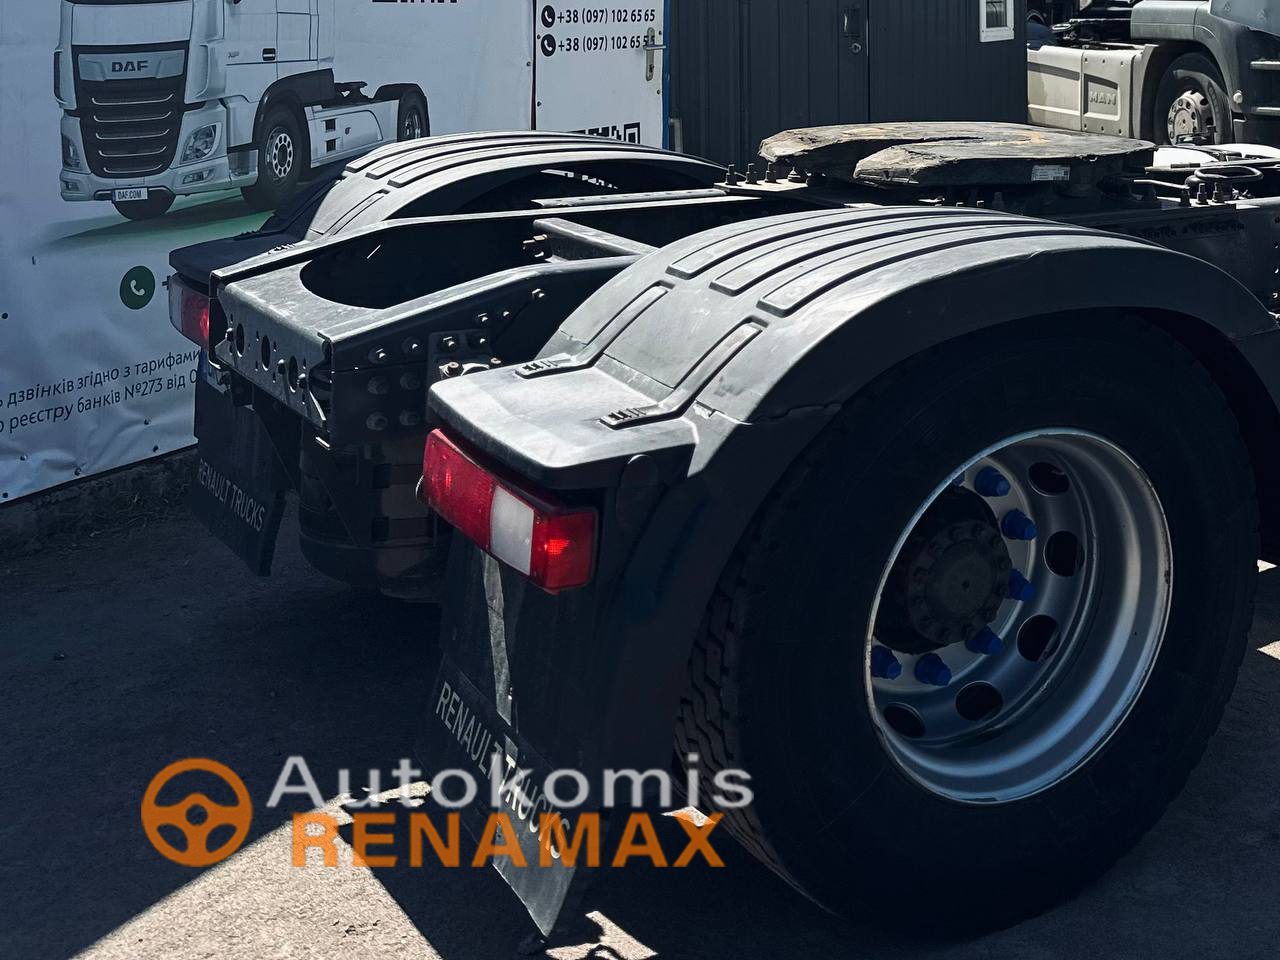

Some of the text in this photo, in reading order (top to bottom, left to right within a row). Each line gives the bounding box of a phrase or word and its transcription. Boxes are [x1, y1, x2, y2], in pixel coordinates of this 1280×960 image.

[557, 7, 656, 25] +38 (097) 102 65 65
[558, 37, 580, 52] +38
[582, 36, 608, 52] (097)
[611, 36, 627, 50] 102
[629, 35, 641, 48] 65
[111, 60, 149, 73] DAF
[1089, 91, 1117, 106] MAN
[7, 378, 75, 408] дзвінків
[77, 367, 120, 390] згідно
[122, 366, 131, 378] з
[134, 349, 200, 376] тарифами
[9, 401, 74, 434] реєстру
[77, 389, 121, 413] банків
[166, 373, 186, 390] від
[230, 483, 266, 532] TRUCKS
[436, 680, 504, 780] RENAULT
